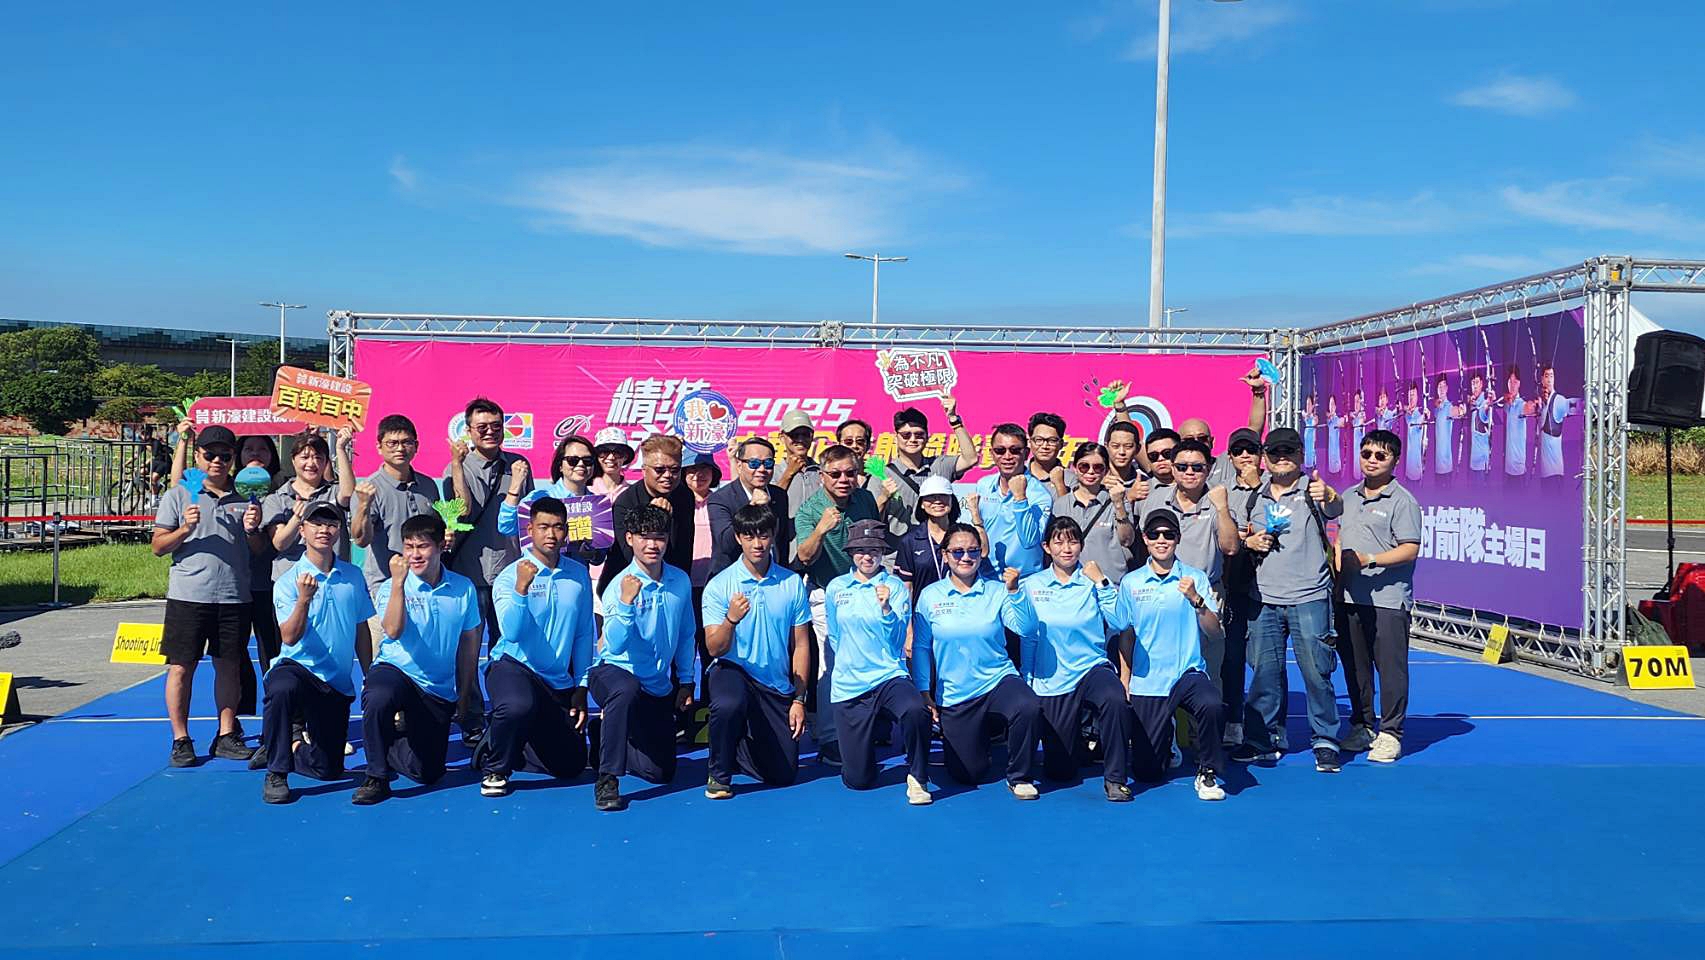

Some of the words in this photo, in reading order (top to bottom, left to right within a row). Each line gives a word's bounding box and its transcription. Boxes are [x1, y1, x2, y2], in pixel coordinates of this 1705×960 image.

[893, 352, 942, 371] 為不凡
[888, 368, 952, 389] 突破極限
[277, 384, 362, 421] 百發百中
[684, 399, 706, 420] 我
[738, 398, 856, 427] 2025
[685, 421, 726, 441] 新濠
[115, 635, 149, 656] Shooting
[1629, 656, 1688, 678] 70M
